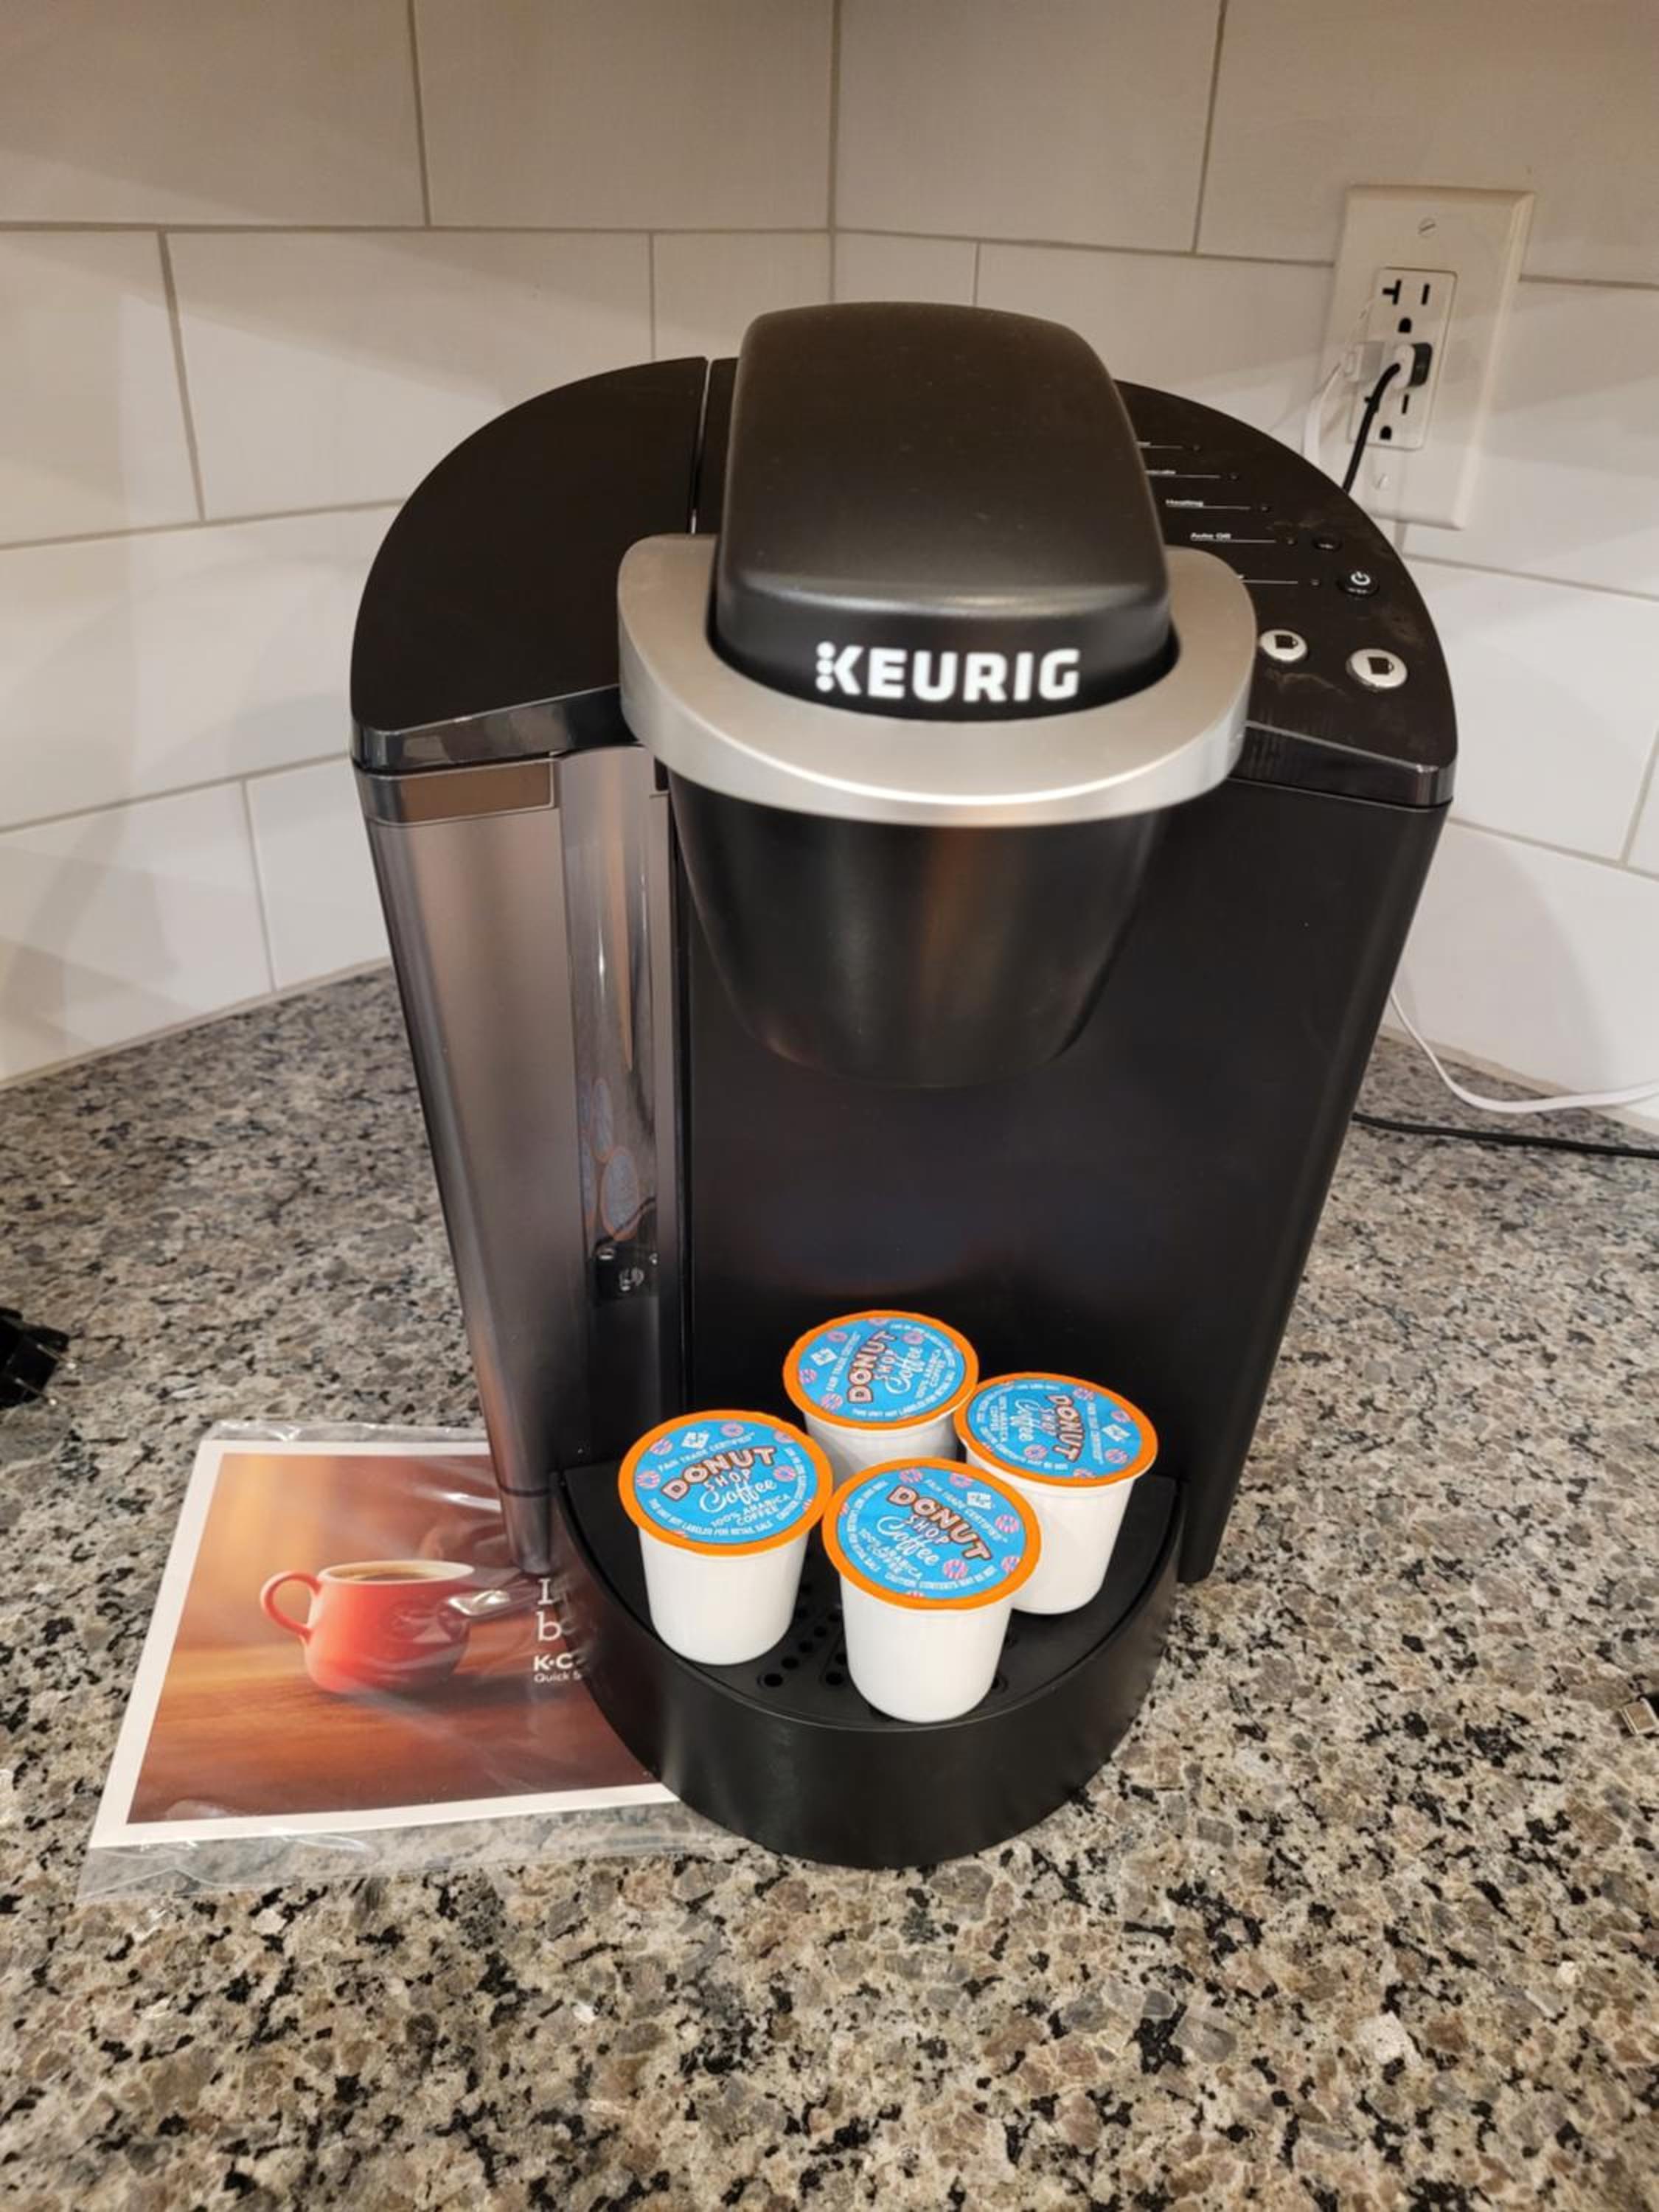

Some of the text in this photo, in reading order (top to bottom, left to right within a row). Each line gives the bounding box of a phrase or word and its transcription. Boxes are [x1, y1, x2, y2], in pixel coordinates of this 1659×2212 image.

[1189, 532, 1231, 541] Auto Off
[815, 641, 1080, 703] KEURIG
[846, 1329, 897, 1404] DONUT
[1046, 1394, 1086, 1464] DONUT
[661, 1446, 778, 1503] DONUT
[699, 1478, 778, 1513] Coffee
[703, 1468, 751, 1492] SHOP
[877, 1514, 940, 1566] Coffee
[886, 1485, 992, 1561] DONUT
[905, 1513, 950, 1544] SHOP
[534, 1672, 569, 1683] Quick
